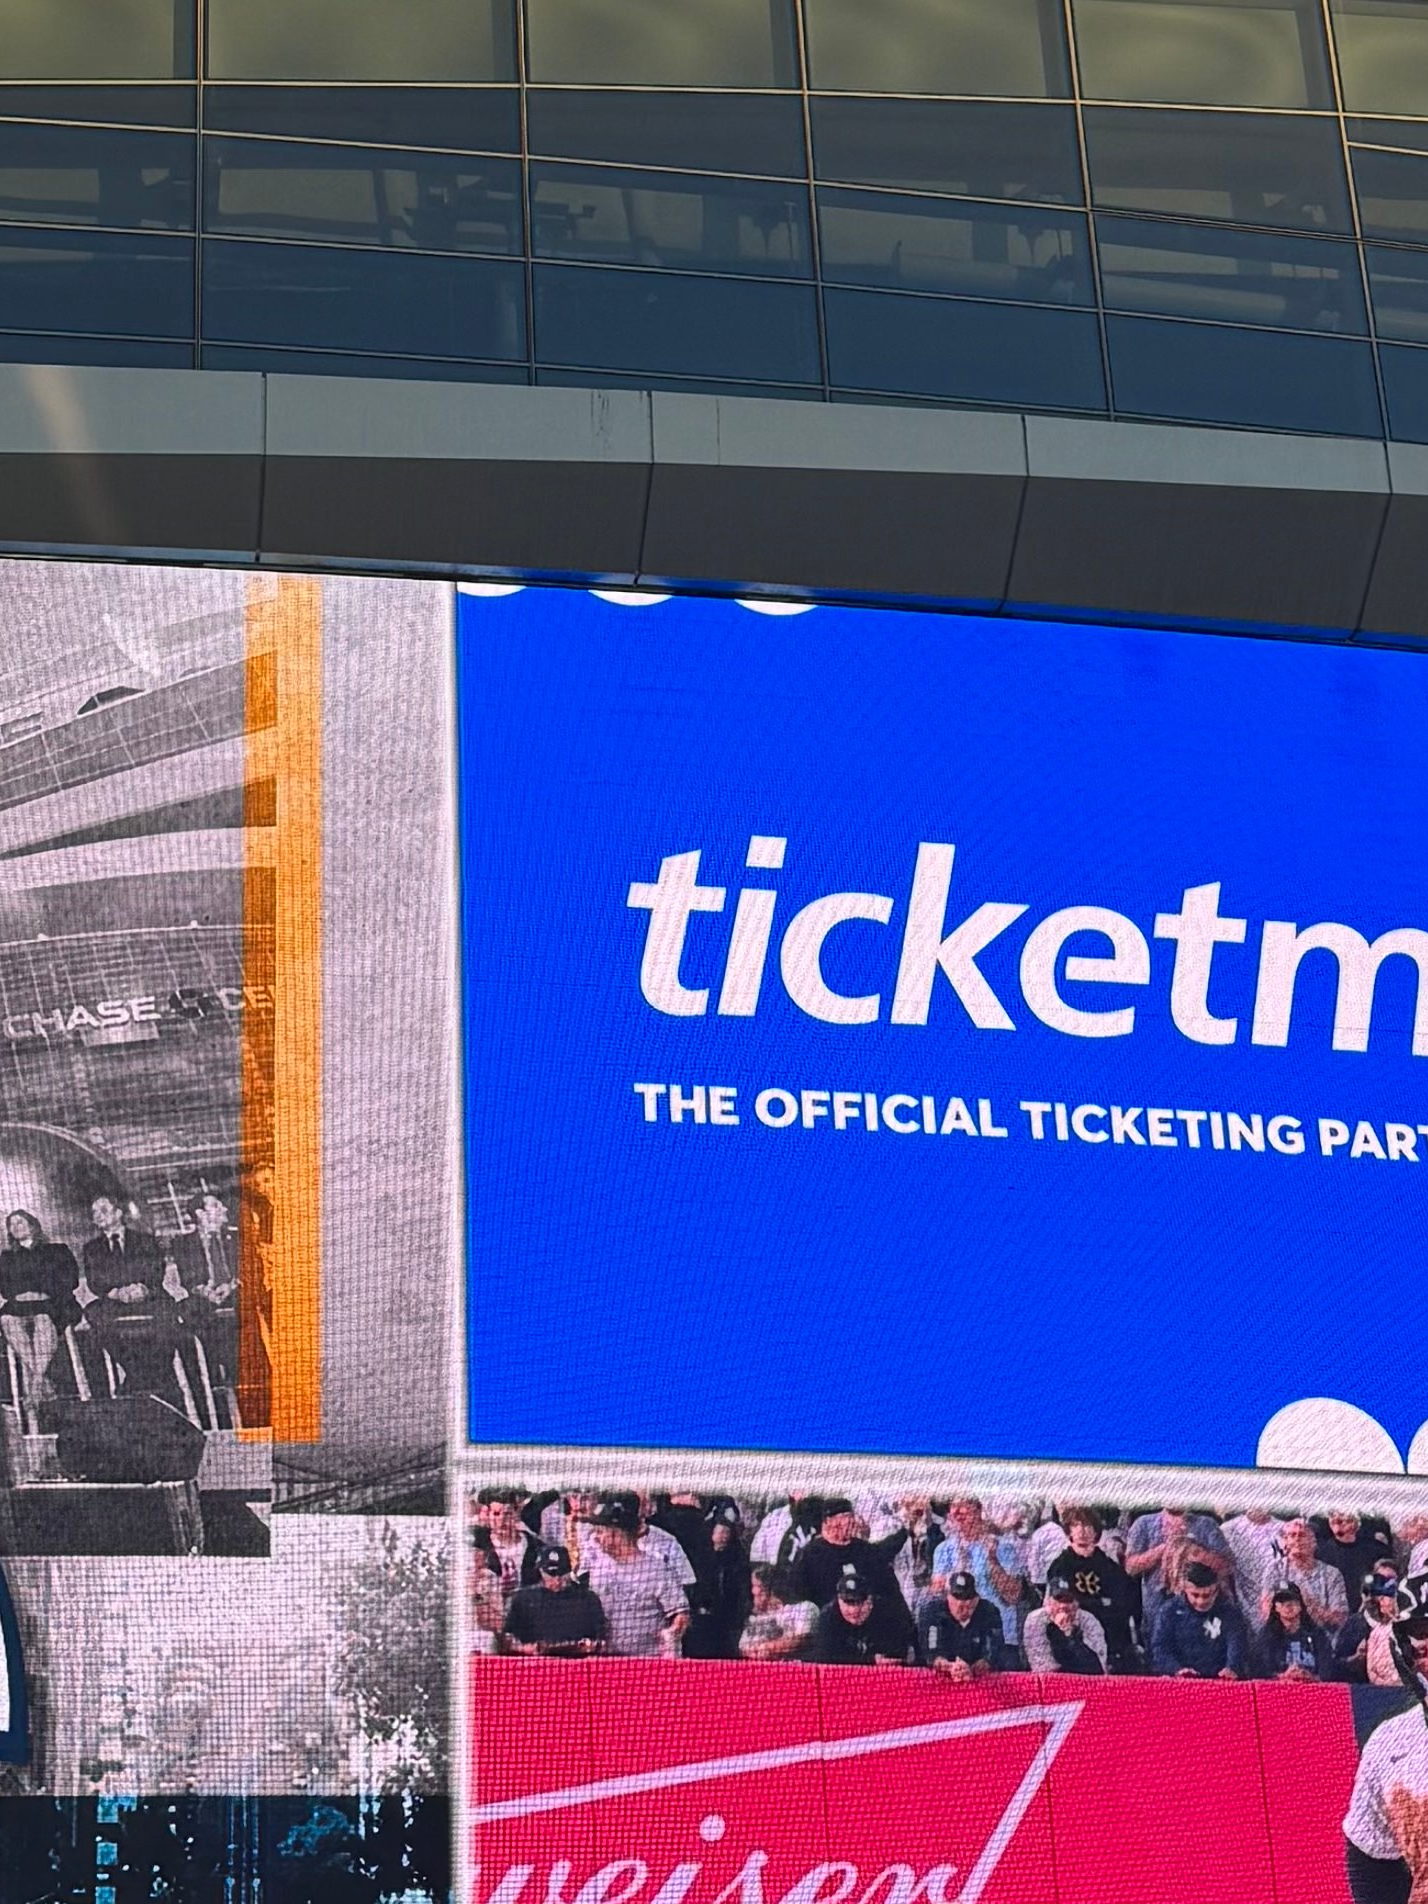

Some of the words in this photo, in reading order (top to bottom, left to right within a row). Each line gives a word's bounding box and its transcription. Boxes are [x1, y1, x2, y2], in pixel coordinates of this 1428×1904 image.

[3, 995, 162, 1042] CHASE
[634, 1082, 740, 1127] THE
[754, 1087, 1008, 1139] OFFICIAL
[1020, 1099, 1306, 1155] TICKETING
